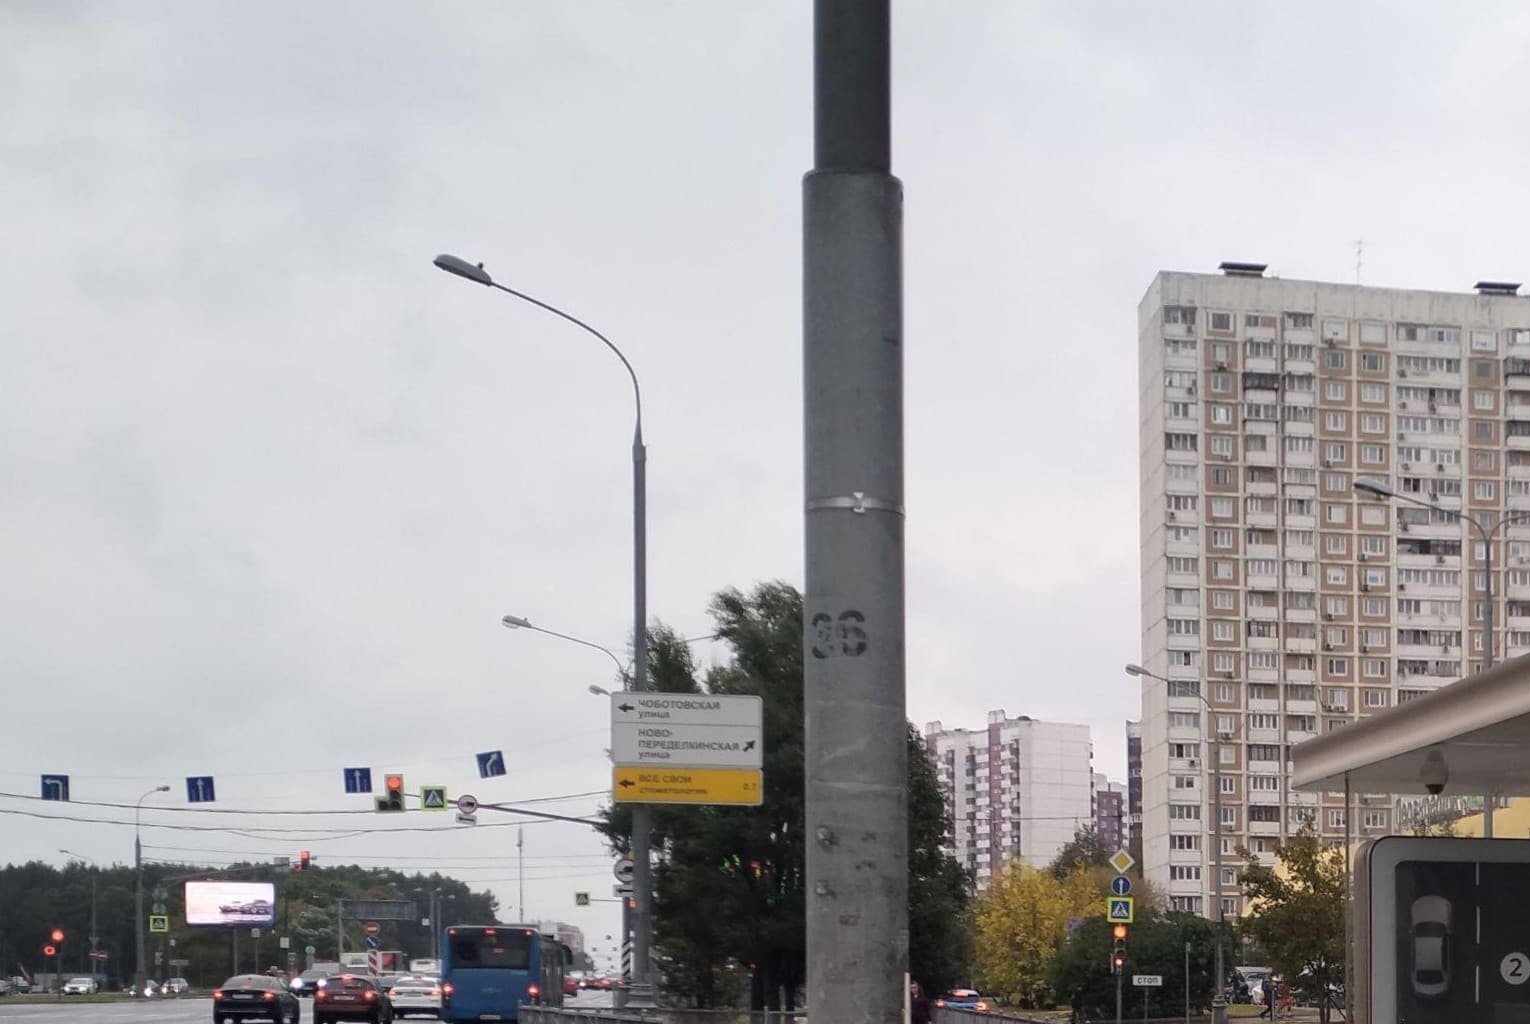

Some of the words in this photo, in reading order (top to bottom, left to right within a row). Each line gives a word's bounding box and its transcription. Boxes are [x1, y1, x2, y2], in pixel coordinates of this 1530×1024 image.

[811, 609, 867, 659] 36
[638, 699, 720, 710] ЧОБОТОВСКАЯ
[638, 711, 670, 720] улица
[638, 728, 673, 737] НОВО-
[638, 740, 740, 751] ПЕРЕДЕЛКИНСКАЯ
[638, 751, 671, 760] улица
[1509, 958, 1523, 977] 2
